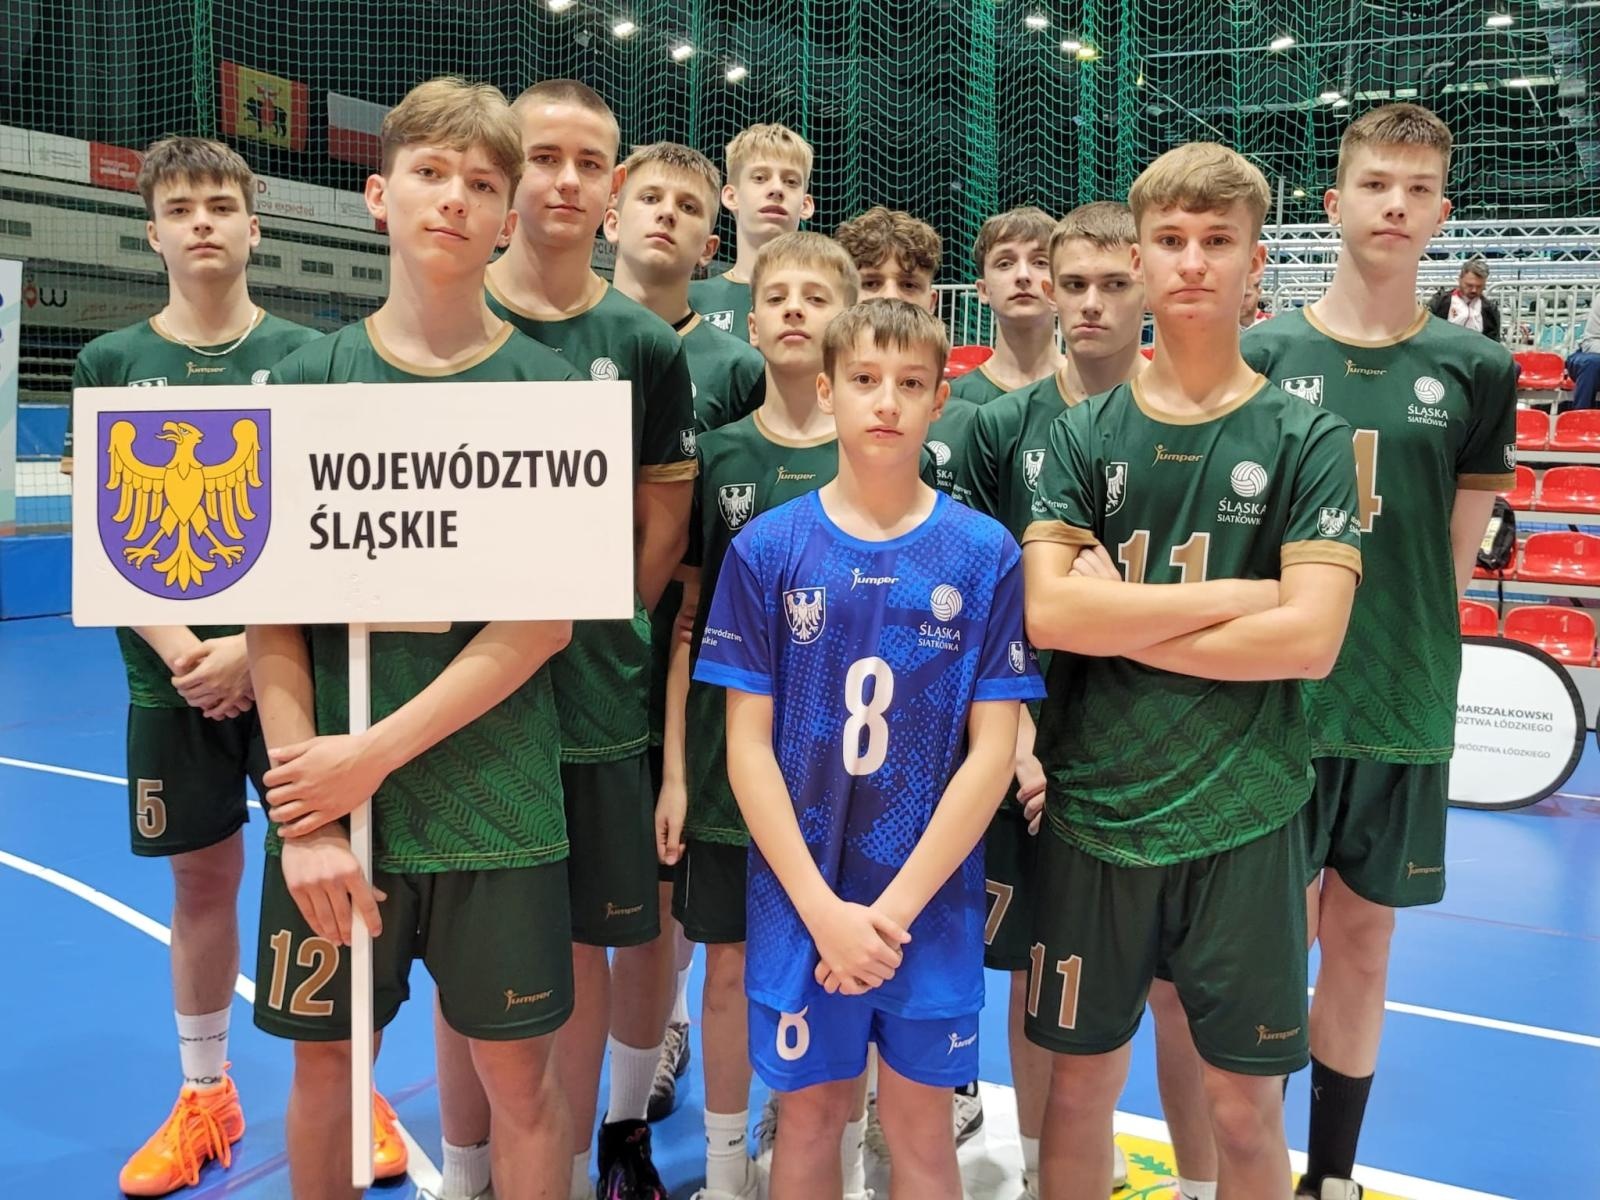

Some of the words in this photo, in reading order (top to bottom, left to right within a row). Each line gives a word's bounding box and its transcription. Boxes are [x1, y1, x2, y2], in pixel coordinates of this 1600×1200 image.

[1407, 403, 1449, 420] ŚLĄSKA
[1407, 416, 1448, 428] SIATKÓWKA
[309, 443, 609, 491] WOJEWÓDZTWO
[936, 469, 953, 480] SKA
[309, 504, 459, 560] ŚLĄSKIE
[704, 626, 743, 643] jewództwo
[919, 620, 961, 641] ŚLĄSKA
[917, 637, 960, 652] SIATKÓWKA
[842, 655, 894, 776] 8
[1457, 704, 1554, 721] MARSZAŁKOWSKI
[1494, 718, 1553, 733] ŁÓDZKIEGO
[1458, 742, 1502, 755] WÓDZTWA
[1503, 747, 1551, 760] ŁÓDZKIEGO
[135, 778, 168, 838] 5
[268, 928, 340, 1017] 12
[1028, 941, 1083, 1030] 11
